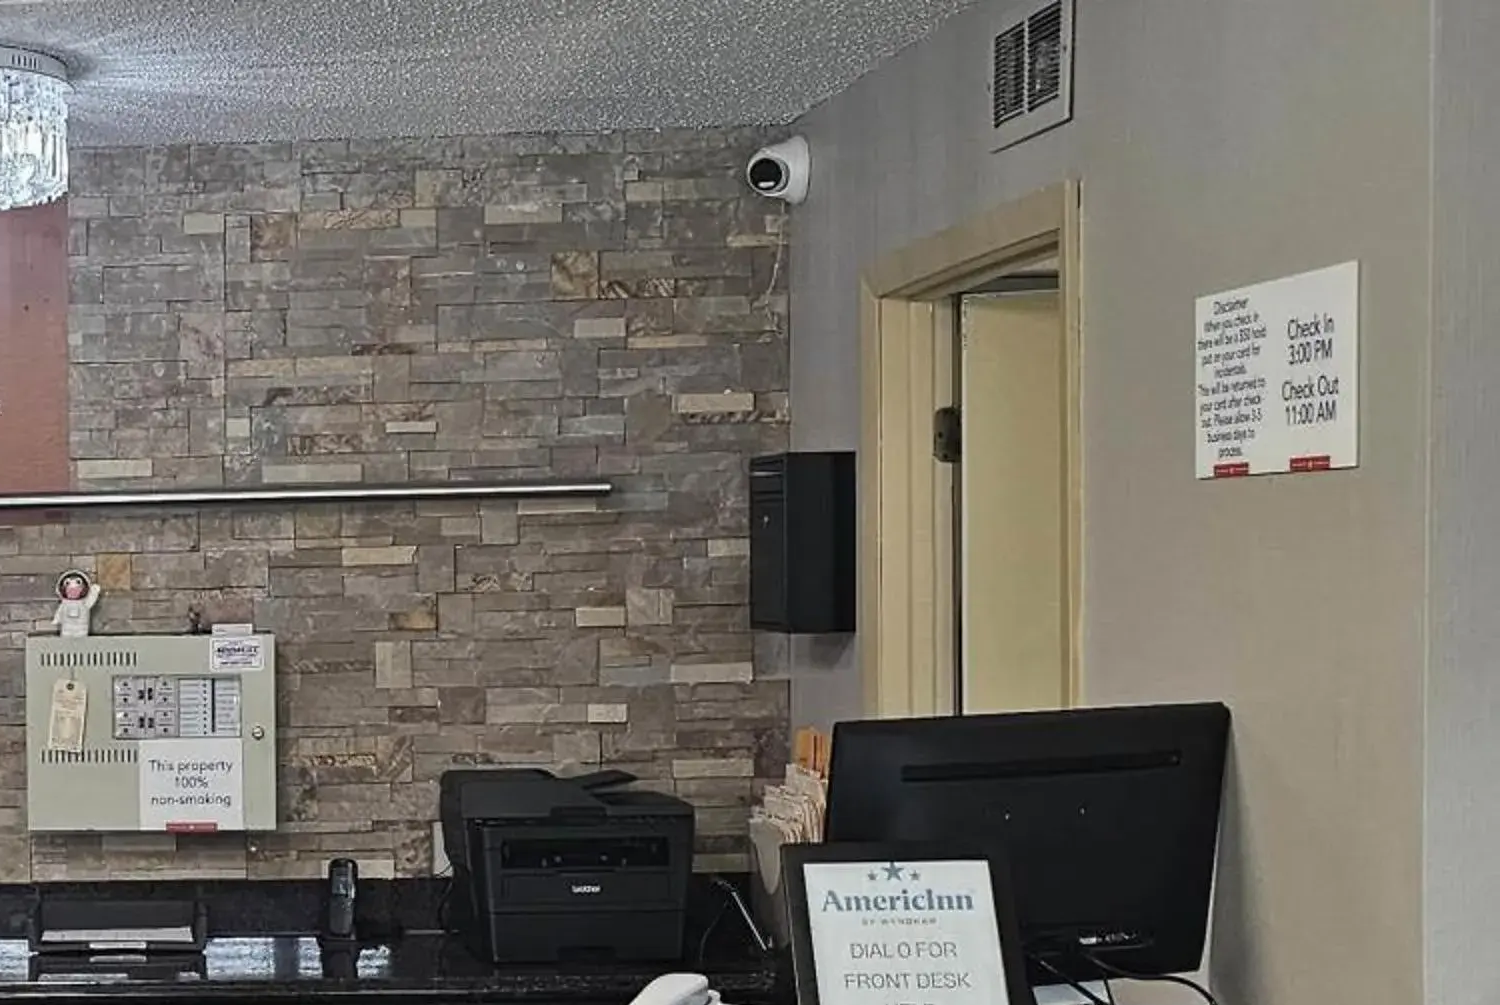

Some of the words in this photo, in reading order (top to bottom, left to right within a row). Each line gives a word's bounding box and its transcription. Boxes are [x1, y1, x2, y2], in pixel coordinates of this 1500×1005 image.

[1287, 313, 1321, 341] Check
[1323, 312, 1334, 333] In
[1288, 341, 1312, 365] 3:00
[1314, 338, 1332, 360] PM
[1282, 375, 1315, 401] Check
[1317, 375, 1339, 396] Out
[1285, 402, 1314, 426] 11:00
[1316, 400, 1337, 423] AM
[148, 759, 175, 772] This
[178, 760, 233, 775] property
[175, 776, 209, 789] 100%
[151, 793, 232, 807] non-smoking
[822, 888, 974, 912] AmericInn
[850, 942, 894, 959] DIAL
[915, 941, 958, 959] FOR
[843, 973, 911, 990] FRONT
[916, 972, 972, 989] DESK
